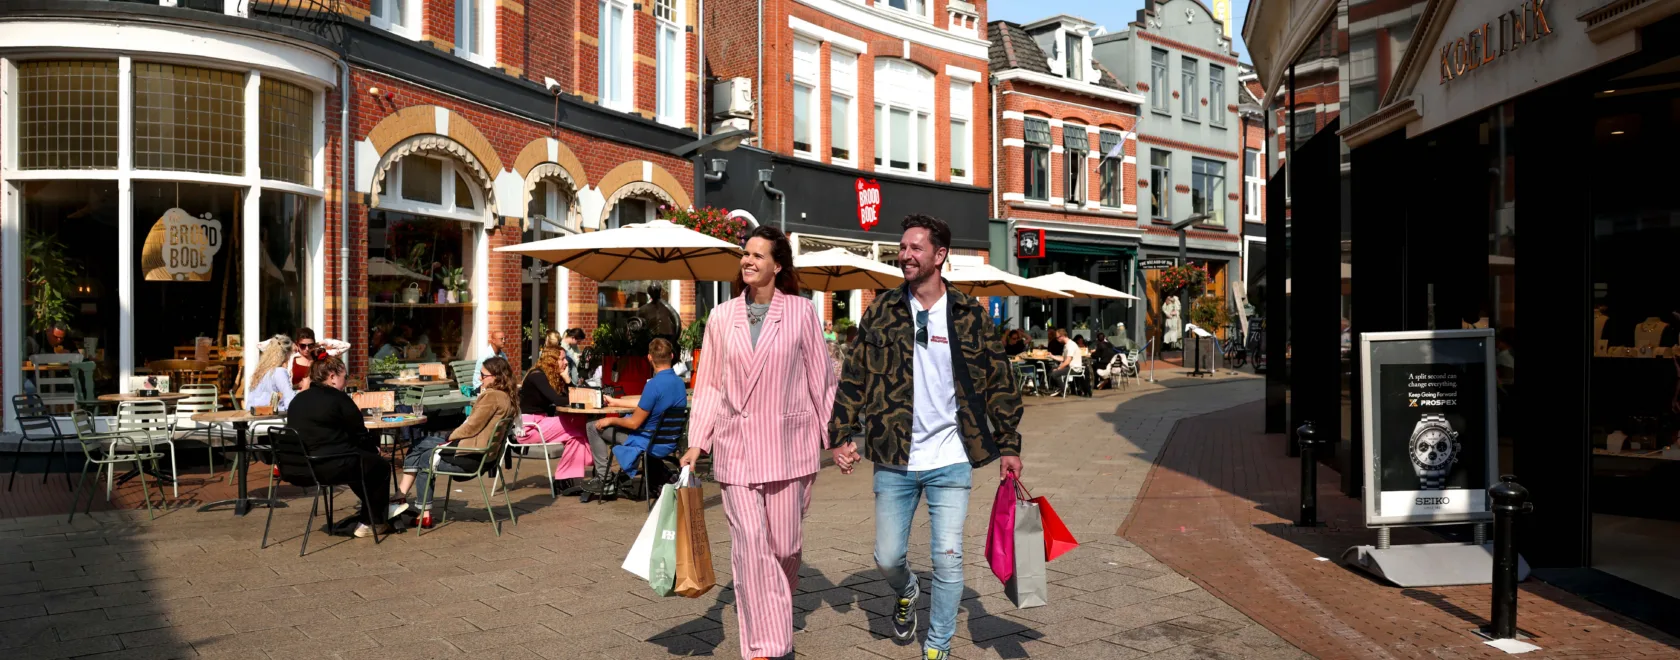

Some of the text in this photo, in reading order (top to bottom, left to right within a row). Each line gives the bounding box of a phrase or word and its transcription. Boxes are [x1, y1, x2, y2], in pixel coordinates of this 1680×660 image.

[1440, 0, 1553, 85] KOELINK
[859, 188, 880, 207] BROOD
[861, 204, 877, 224] BODE
[170, 224, 217, 247] BROOD
[170, 246, 207, 268] BODE
[1415, 373, 1427, 381] split
[1421, 391, 1436, 399] Going
[1415, 497, 1450, 506] SEIKO
